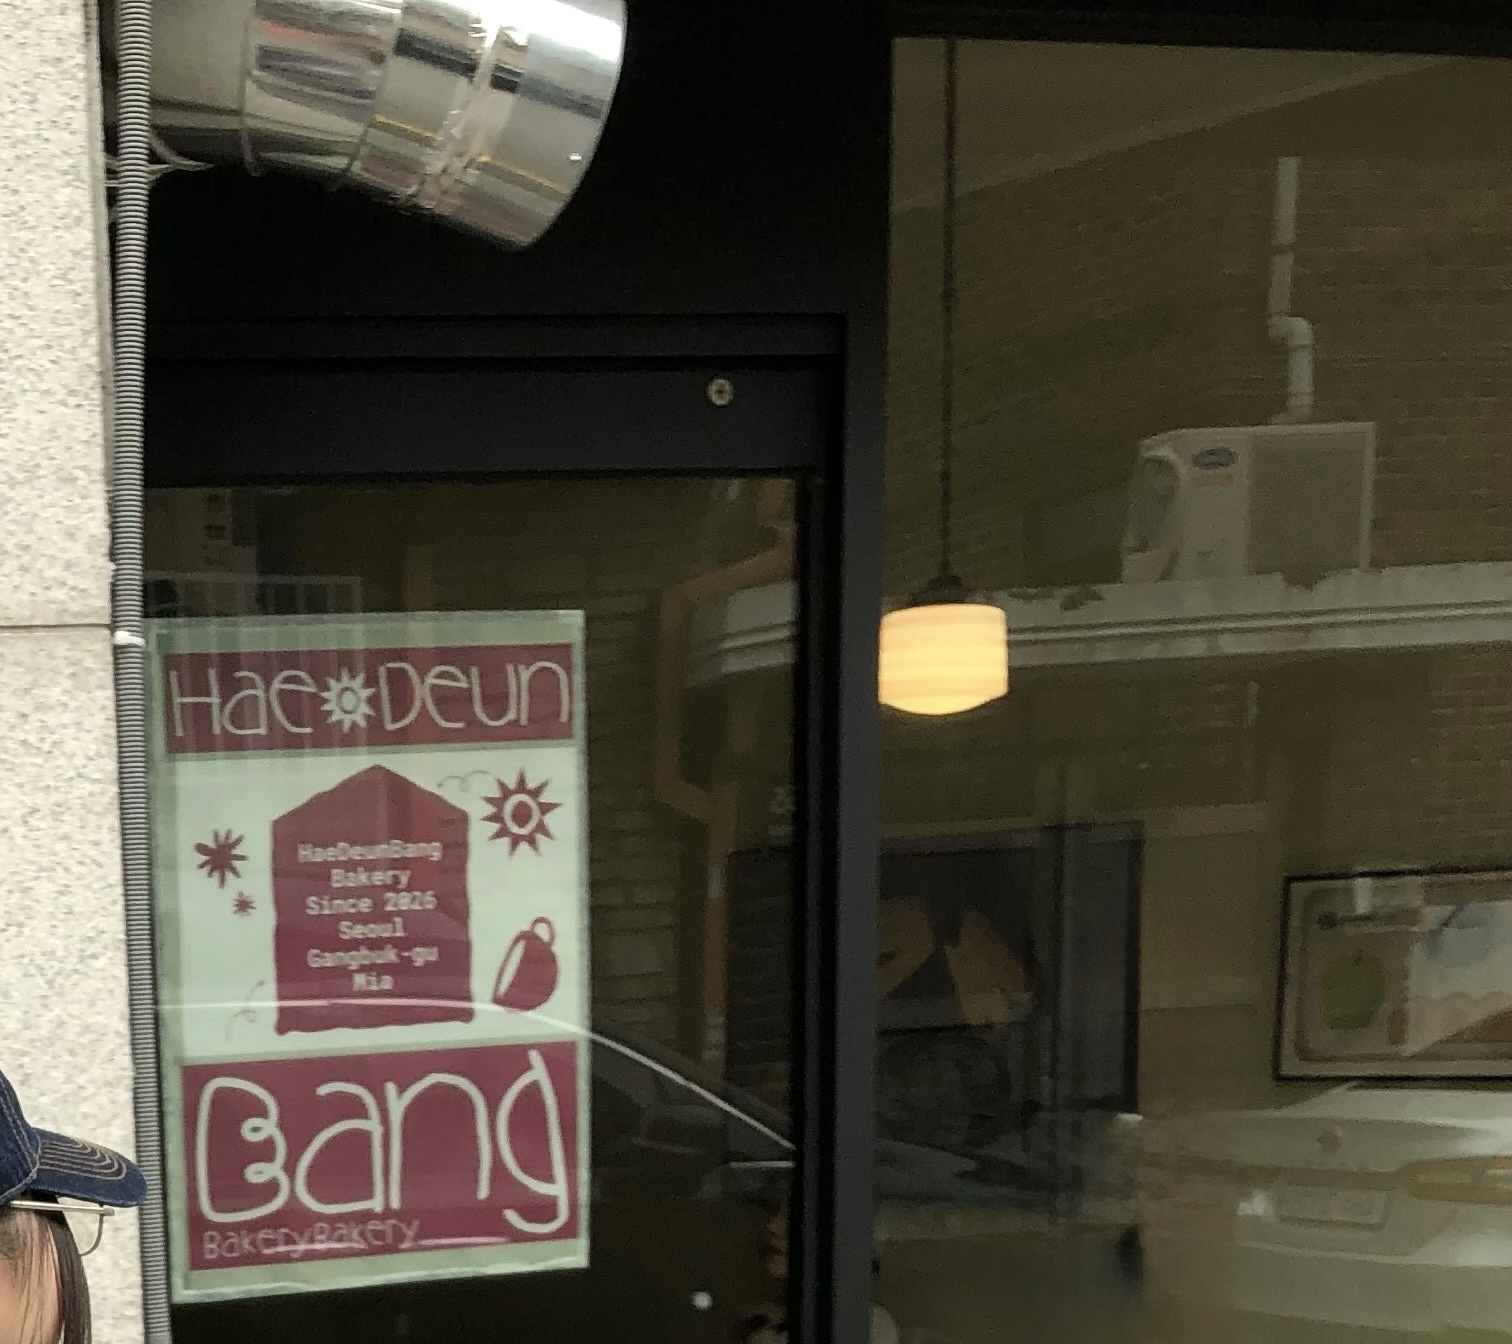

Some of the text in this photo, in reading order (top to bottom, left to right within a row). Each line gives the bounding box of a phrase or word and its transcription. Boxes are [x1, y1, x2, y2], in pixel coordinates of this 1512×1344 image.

[169, 659, 570, 736] Hae Deun
[297, 839, 443, 863] HaeDeunBang
[330, 866, 412, 888] Bakery
[305, 896, 374, 915] Since
[338, 917, 405, 940] Seoul
[307, 944, 440, 970] Gangbuk-gu
[352, 971, 394, 991] Mia
[196, 1050, 570, 1233] Bang
